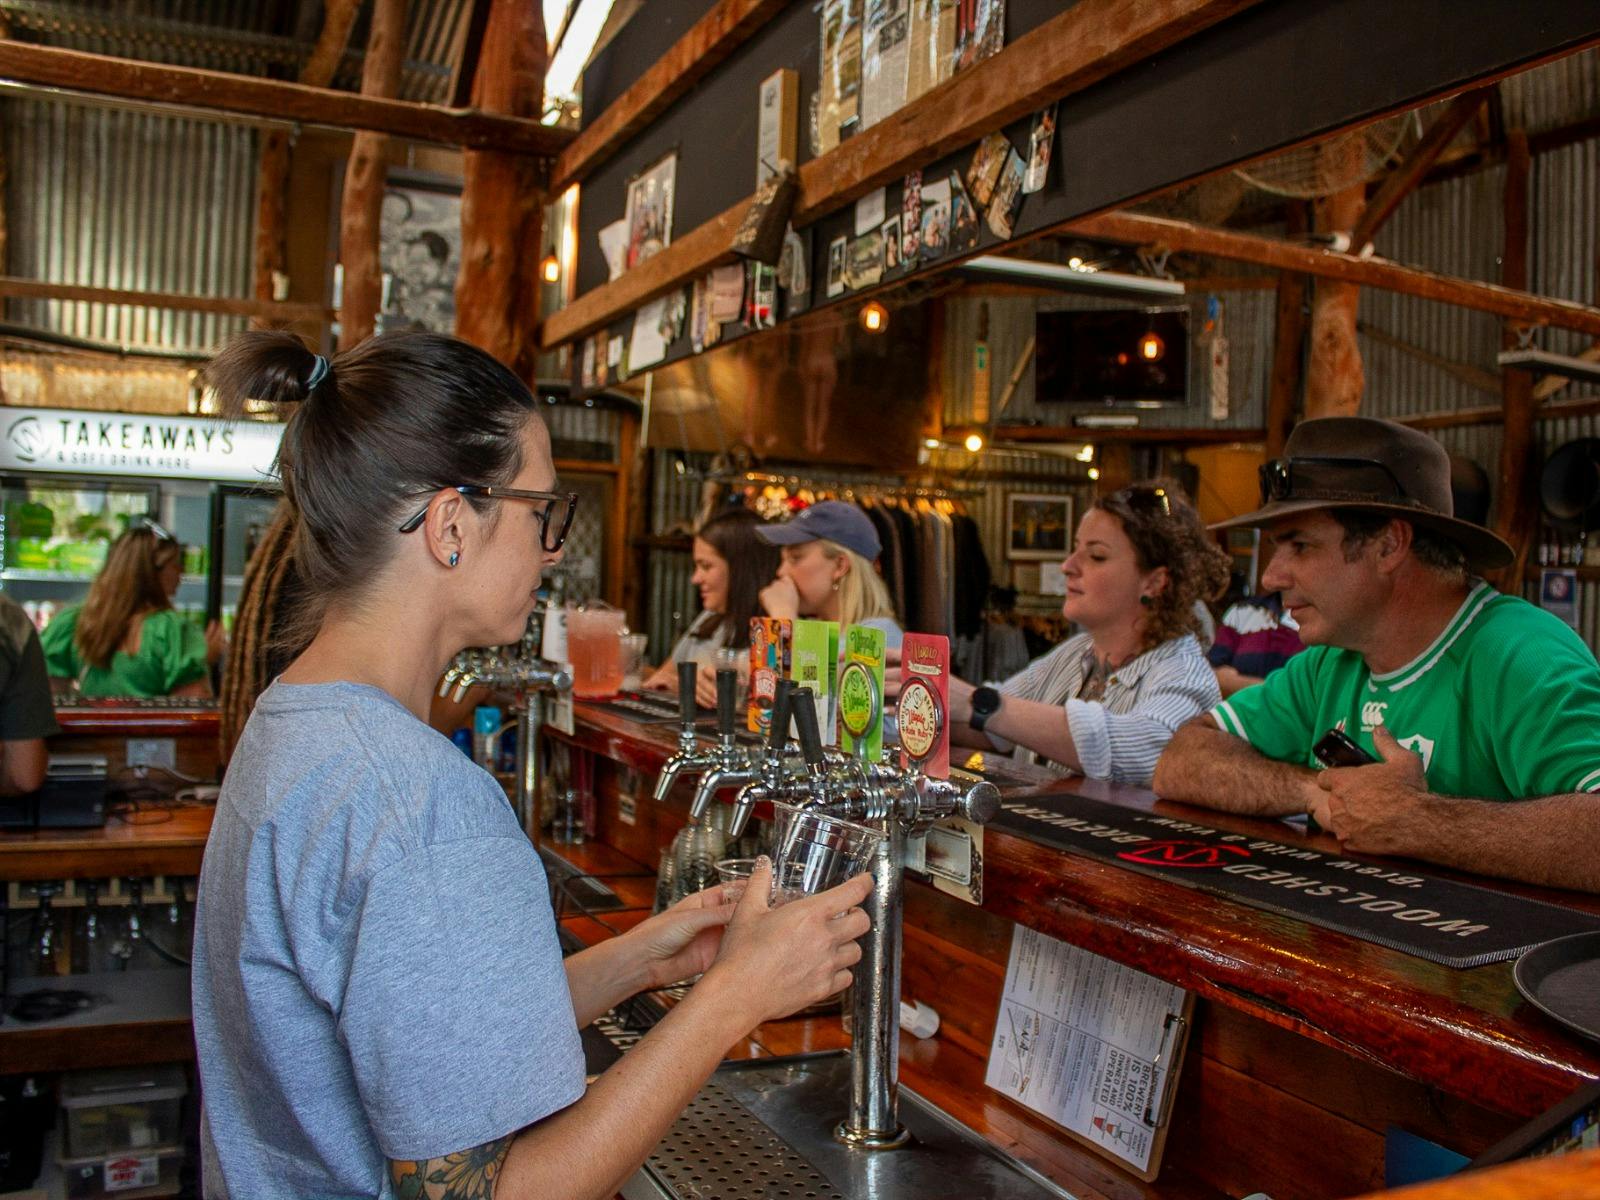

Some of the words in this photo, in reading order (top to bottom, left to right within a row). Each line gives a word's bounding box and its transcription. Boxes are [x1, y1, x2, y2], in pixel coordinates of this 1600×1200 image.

[58, 419, 235, 455] TAKEAWAYS
[157, 456, 191, 470] HERE
[1219, 833, 1240, 843] a
[1247, 840, 1319, 869] with
[1222, 864, 1490, 938] WOOLSHED
[1100, 1049, 1118, 1103] OPERATED
[1112, 1053, 1126, 1085] OWNED
[1130, 1060, 1141, 1074] IS
[1108, 1086, 1118, 1106] AND
[1122, 1077, 1138, 1113] 100%
[1131, 1061, 1152, 1120] BREWERY
